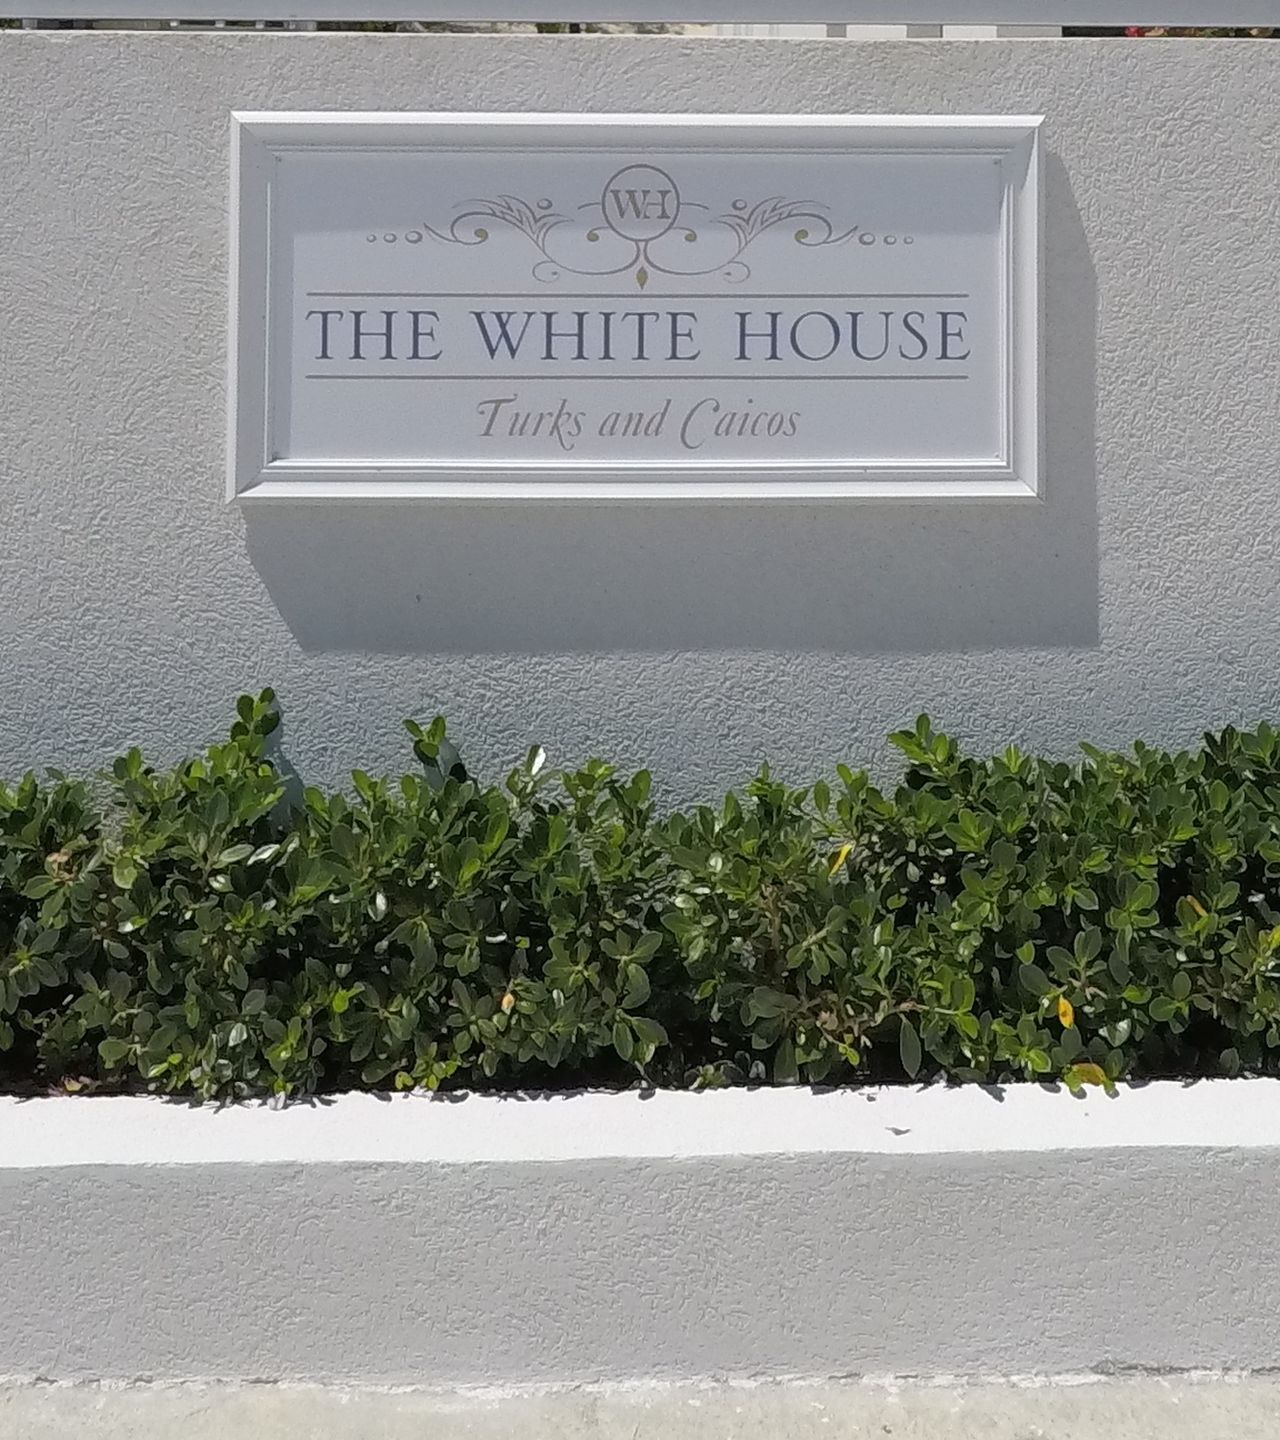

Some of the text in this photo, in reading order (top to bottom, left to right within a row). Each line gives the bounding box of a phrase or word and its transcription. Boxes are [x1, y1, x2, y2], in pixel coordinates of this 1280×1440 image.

[305, 310, 972, 362] THE WHITE HOUSE
[477, 394, 801, 451] Turks and Caicos
